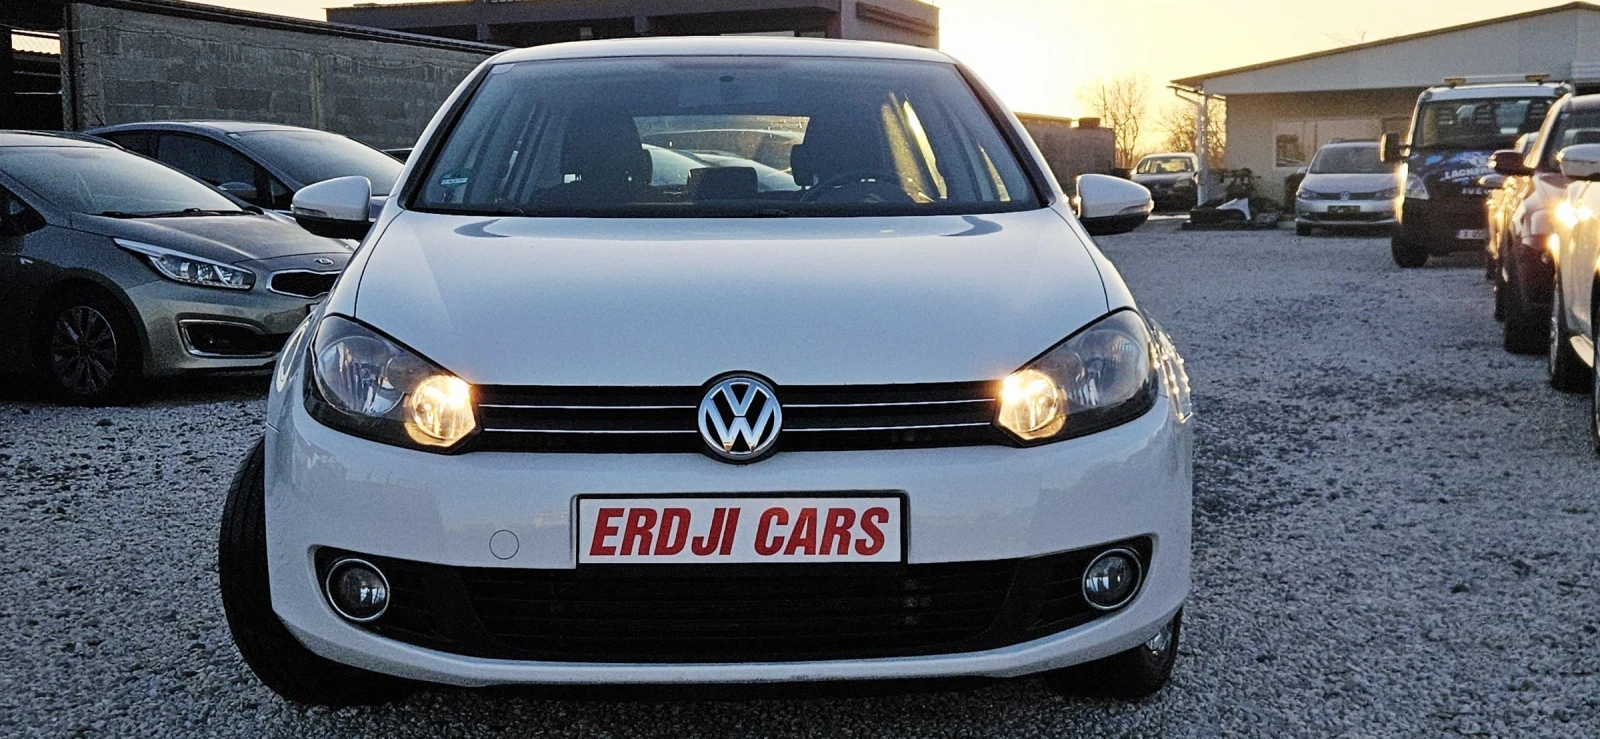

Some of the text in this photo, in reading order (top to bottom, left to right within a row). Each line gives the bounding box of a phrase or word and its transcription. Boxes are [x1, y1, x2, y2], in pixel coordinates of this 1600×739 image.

[704, 380, 776, 454] VW
[589, 506, 890, 557] ERDJI CARS
